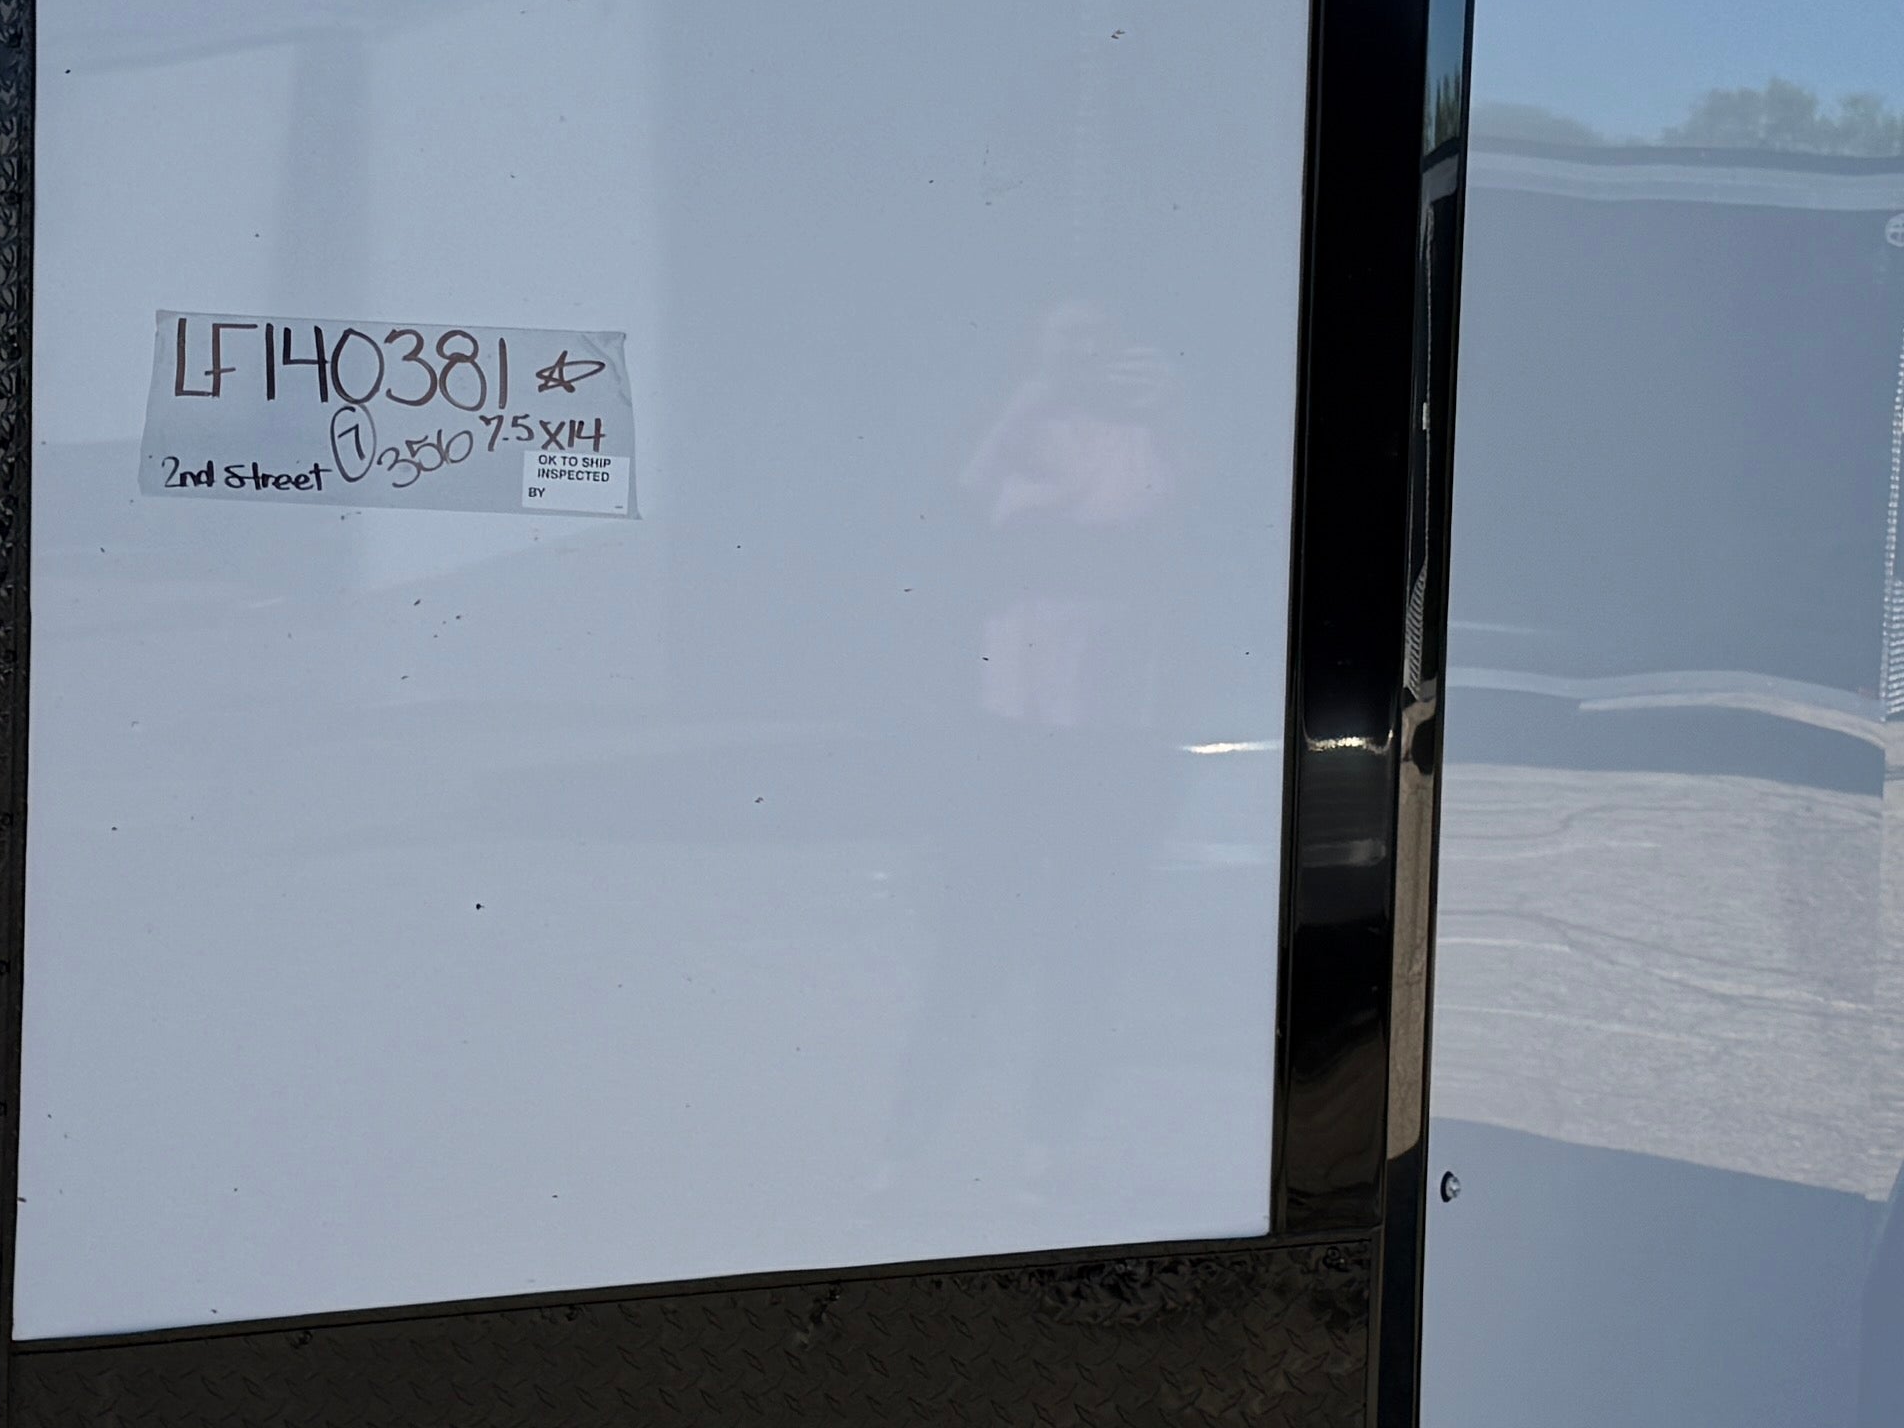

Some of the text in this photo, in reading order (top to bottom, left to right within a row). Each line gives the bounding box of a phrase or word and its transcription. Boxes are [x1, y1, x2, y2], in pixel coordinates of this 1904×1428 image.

[174, 317, 508, 412] LF140381
[538, 454, 611, 469] OK TO SHIP
[161, 456, 333, 491] 2nd Street
[537, 468, 610, 483] INSPECTED
[528, 487, 546, 498] BY
